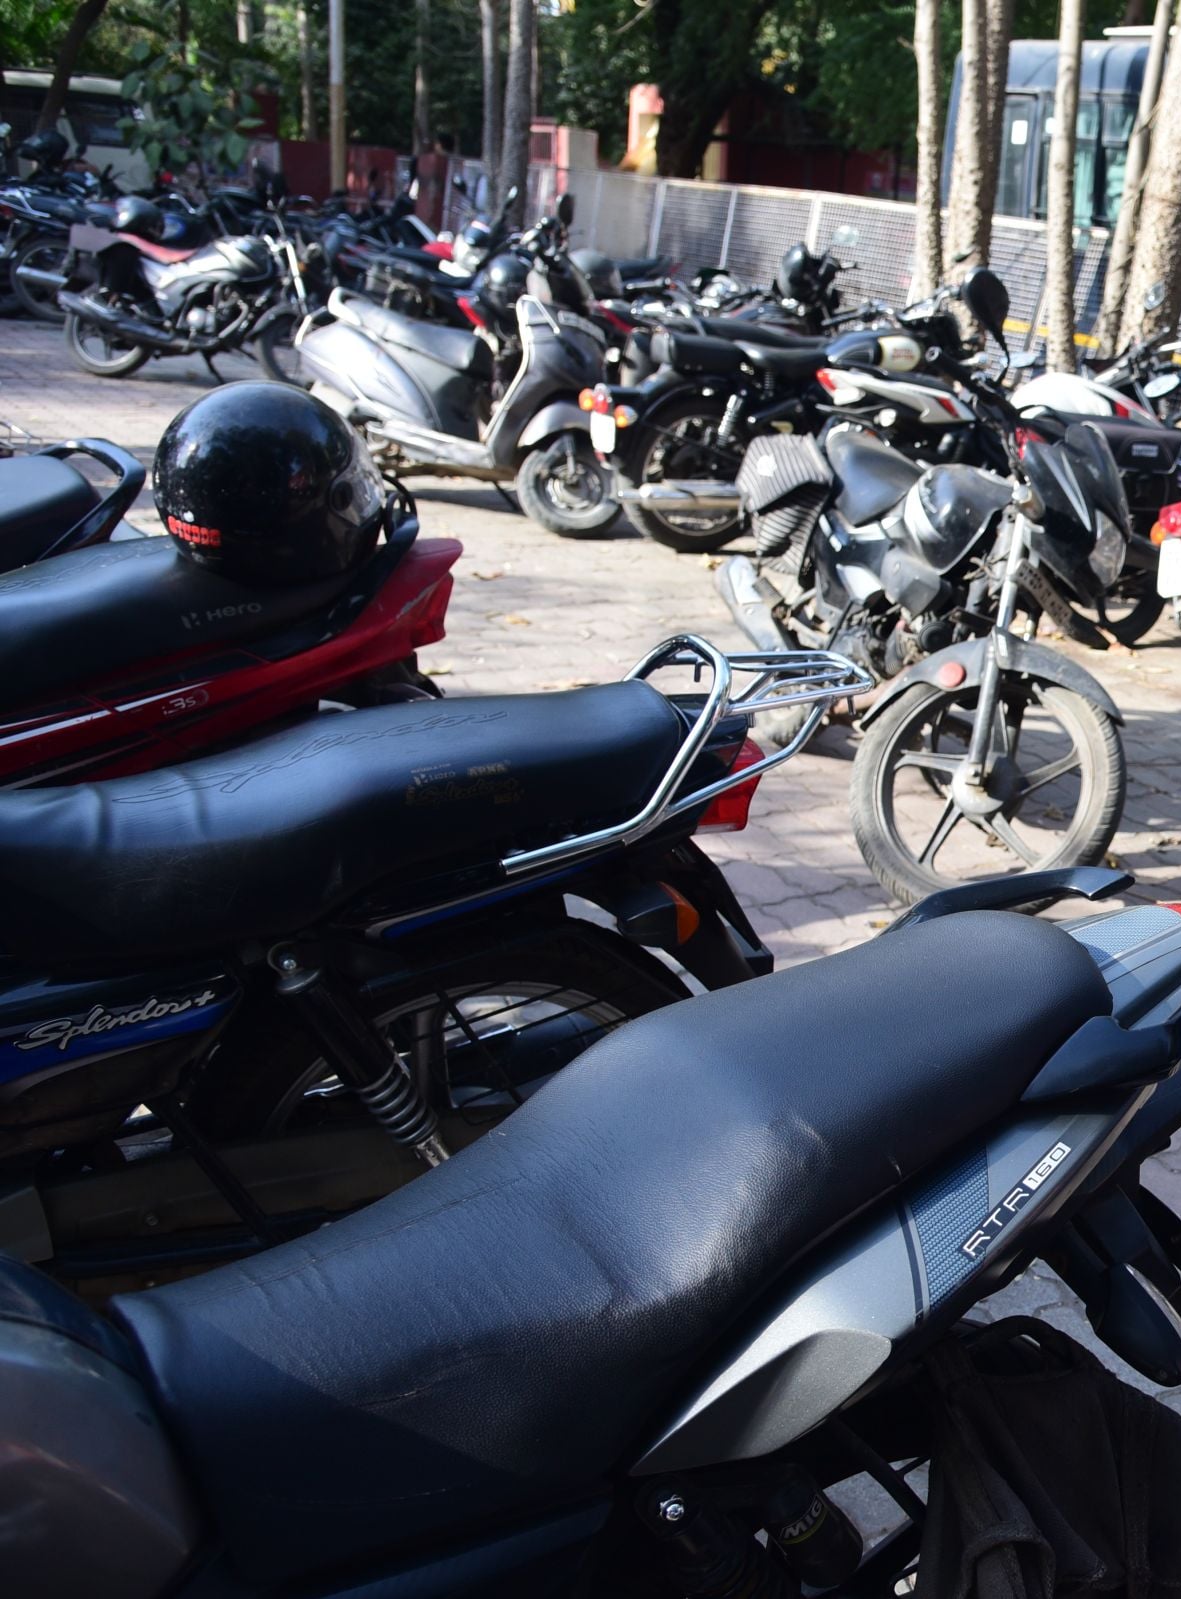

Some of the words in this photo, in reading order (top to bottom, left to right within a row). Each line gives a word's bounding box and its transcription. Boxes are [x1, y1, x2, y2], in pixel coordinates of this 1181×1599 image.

[206, 602, 262, 621] Hero
[963, 1187, 1030, 1257] RTR
[1026, 1145, 1068, 1186] 160
